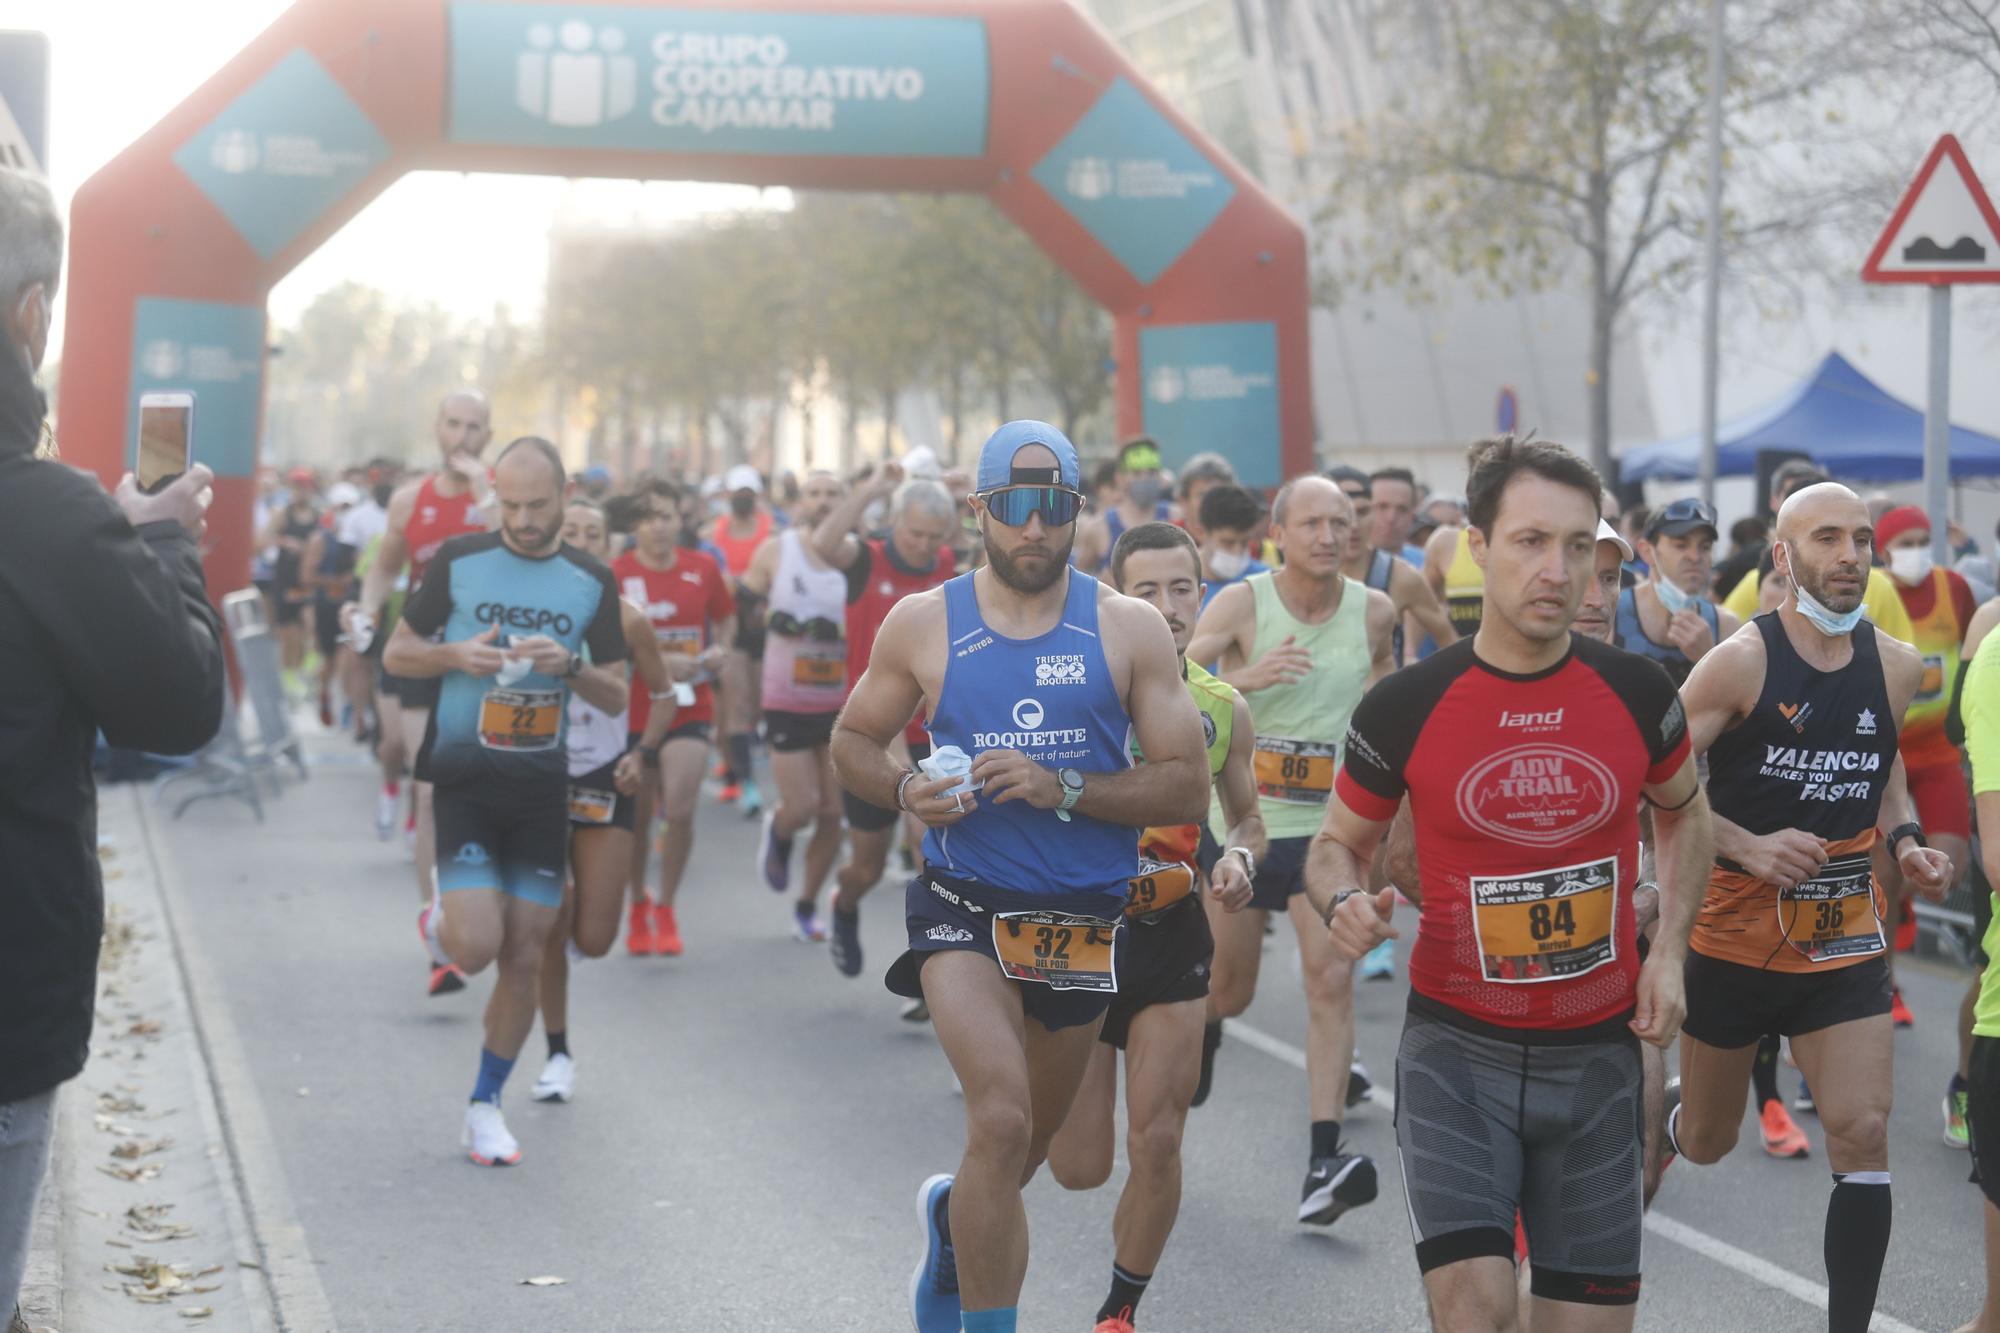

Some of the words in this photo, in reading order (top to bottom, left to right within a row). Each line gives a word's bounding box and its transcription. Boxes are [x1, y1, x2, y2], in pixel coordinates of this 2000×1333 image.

[652, 32, 788, 67] GRUPO
[652, 65, 924, 101] COOPERATIVO
[652, 98, 836, 132] CAJAMAR
[475, 602, 573, 635] CRESPO
[1035, 654, 1085, 665] TRIESPORT
[1036, 676, 1087, 687] ROQUETTE
[511, 707, 537, 730] 22
[1498, 708, 1564, 728] land
[972, 728, 1087, 749] ROQUETTE
[1026, 752, 1045, 761] best
[1047, 750, 1058, 762] of
[1764, 744, 1880, 772] VALENCIA
[1281, 756, 1309, 780] 86
[1509, 757, 1564, 779] ADV
[1760, 765, 1805, 781] MAKES
[1808, 772, 1833, 783] YOU
[1499, 775, 1578, 798] TRAIL
[930, 881, 960, 905] arena
[1127, 877, 1156, 907] 29
[1476, 881, 1499, 897] 10K
[1499, 881, 1521, 893] PAS
[1522, 881, 1545, 893] RAS
[1799, 883, 1816, 892] PAS
[1817, 884, 1831, 894] RAS
[1528, 899, 1576, 941] 84
[1815, 901, 1844, 931] 36
[1034, 927, 1073, 960] 32
[1035, 958, 1049, 969] DEL
[1050, 960, 1069, 970] POZO
